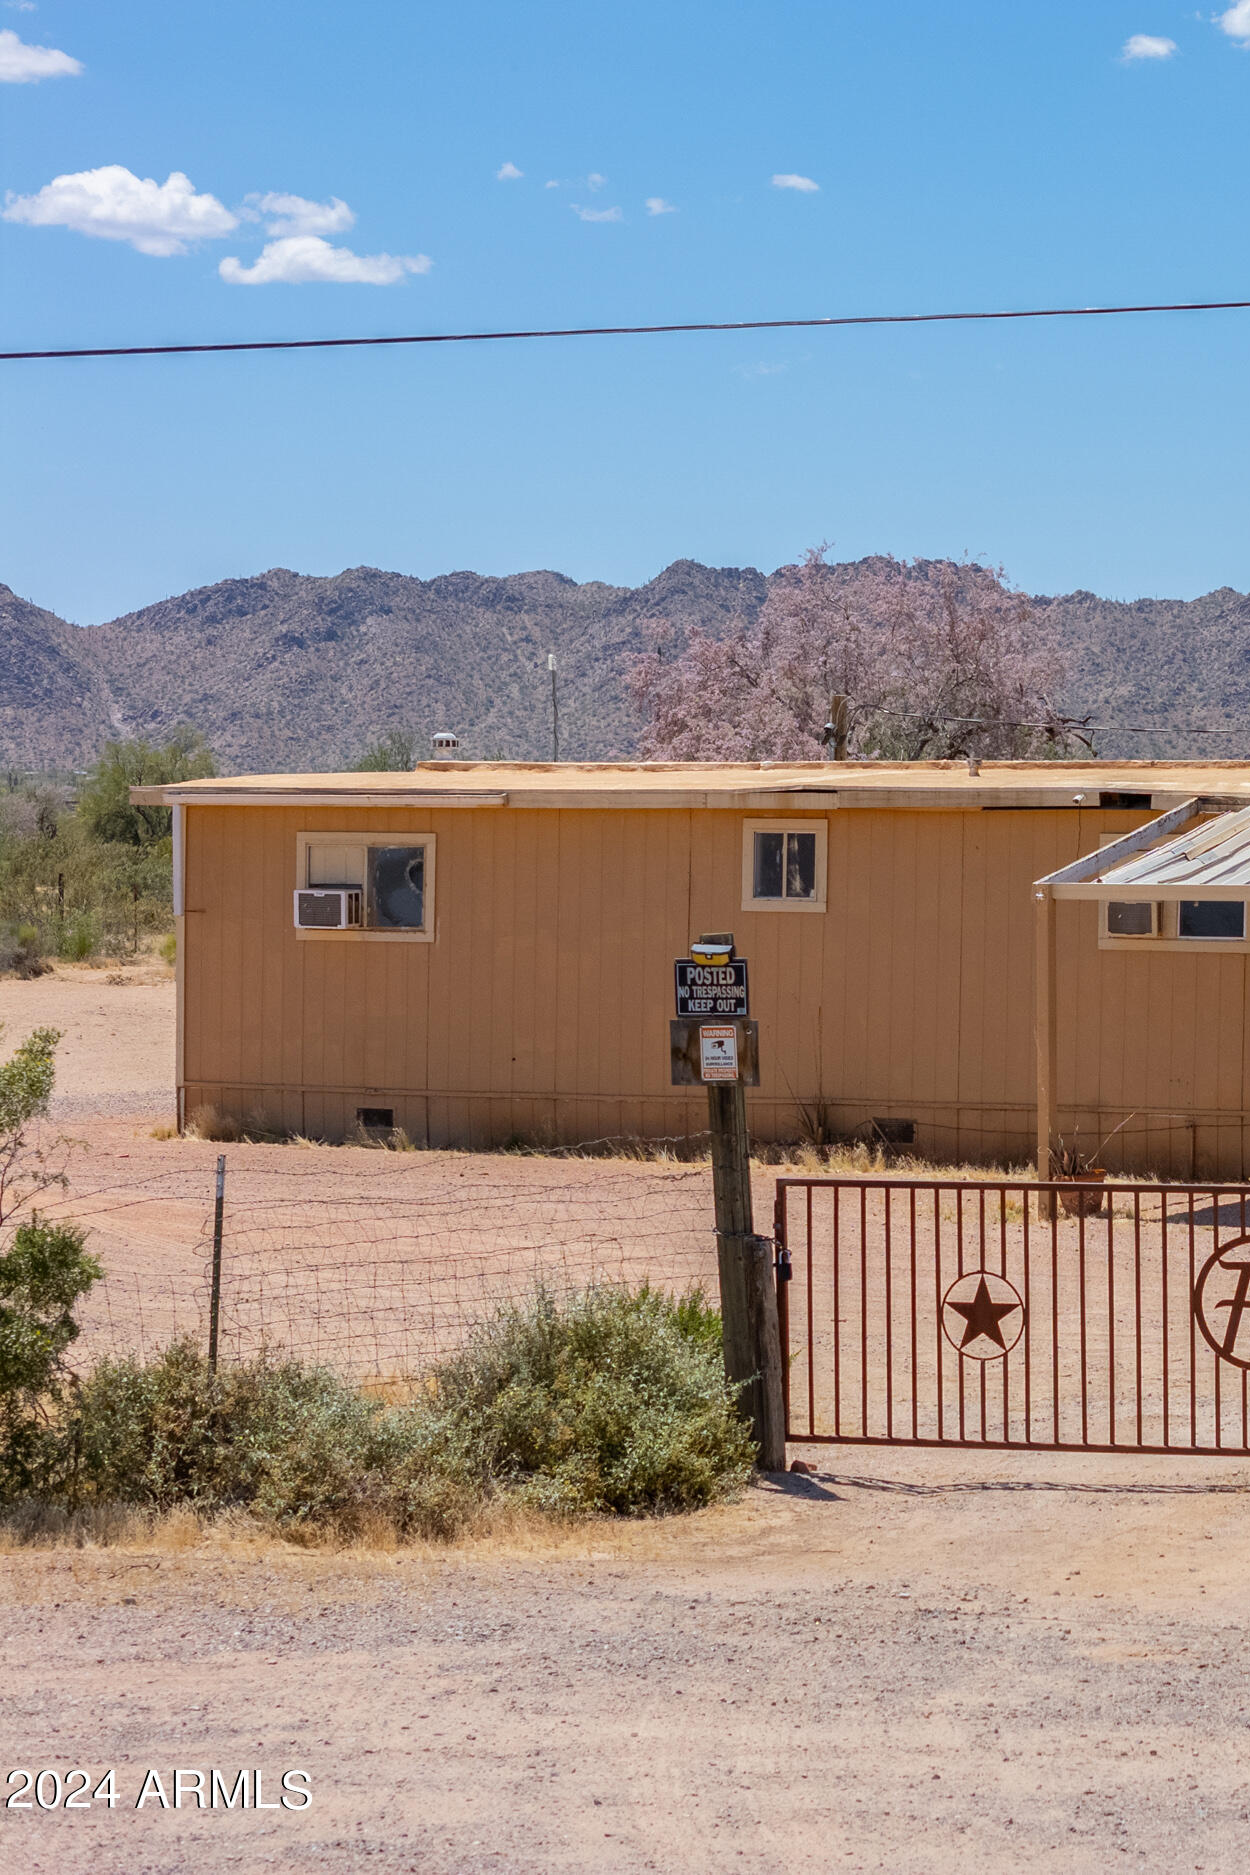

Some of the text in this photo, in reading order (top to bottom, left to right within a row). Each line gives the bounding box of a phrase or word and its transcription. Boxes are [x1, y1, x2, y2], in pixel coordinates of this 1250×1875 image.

[687, 967, 735, 985] POSTED
[679, 986, 745, 998] NO TRESPASSING
[688, 999, 713, 1012] KEEP
[716, 999, 736, 1012] OUT
